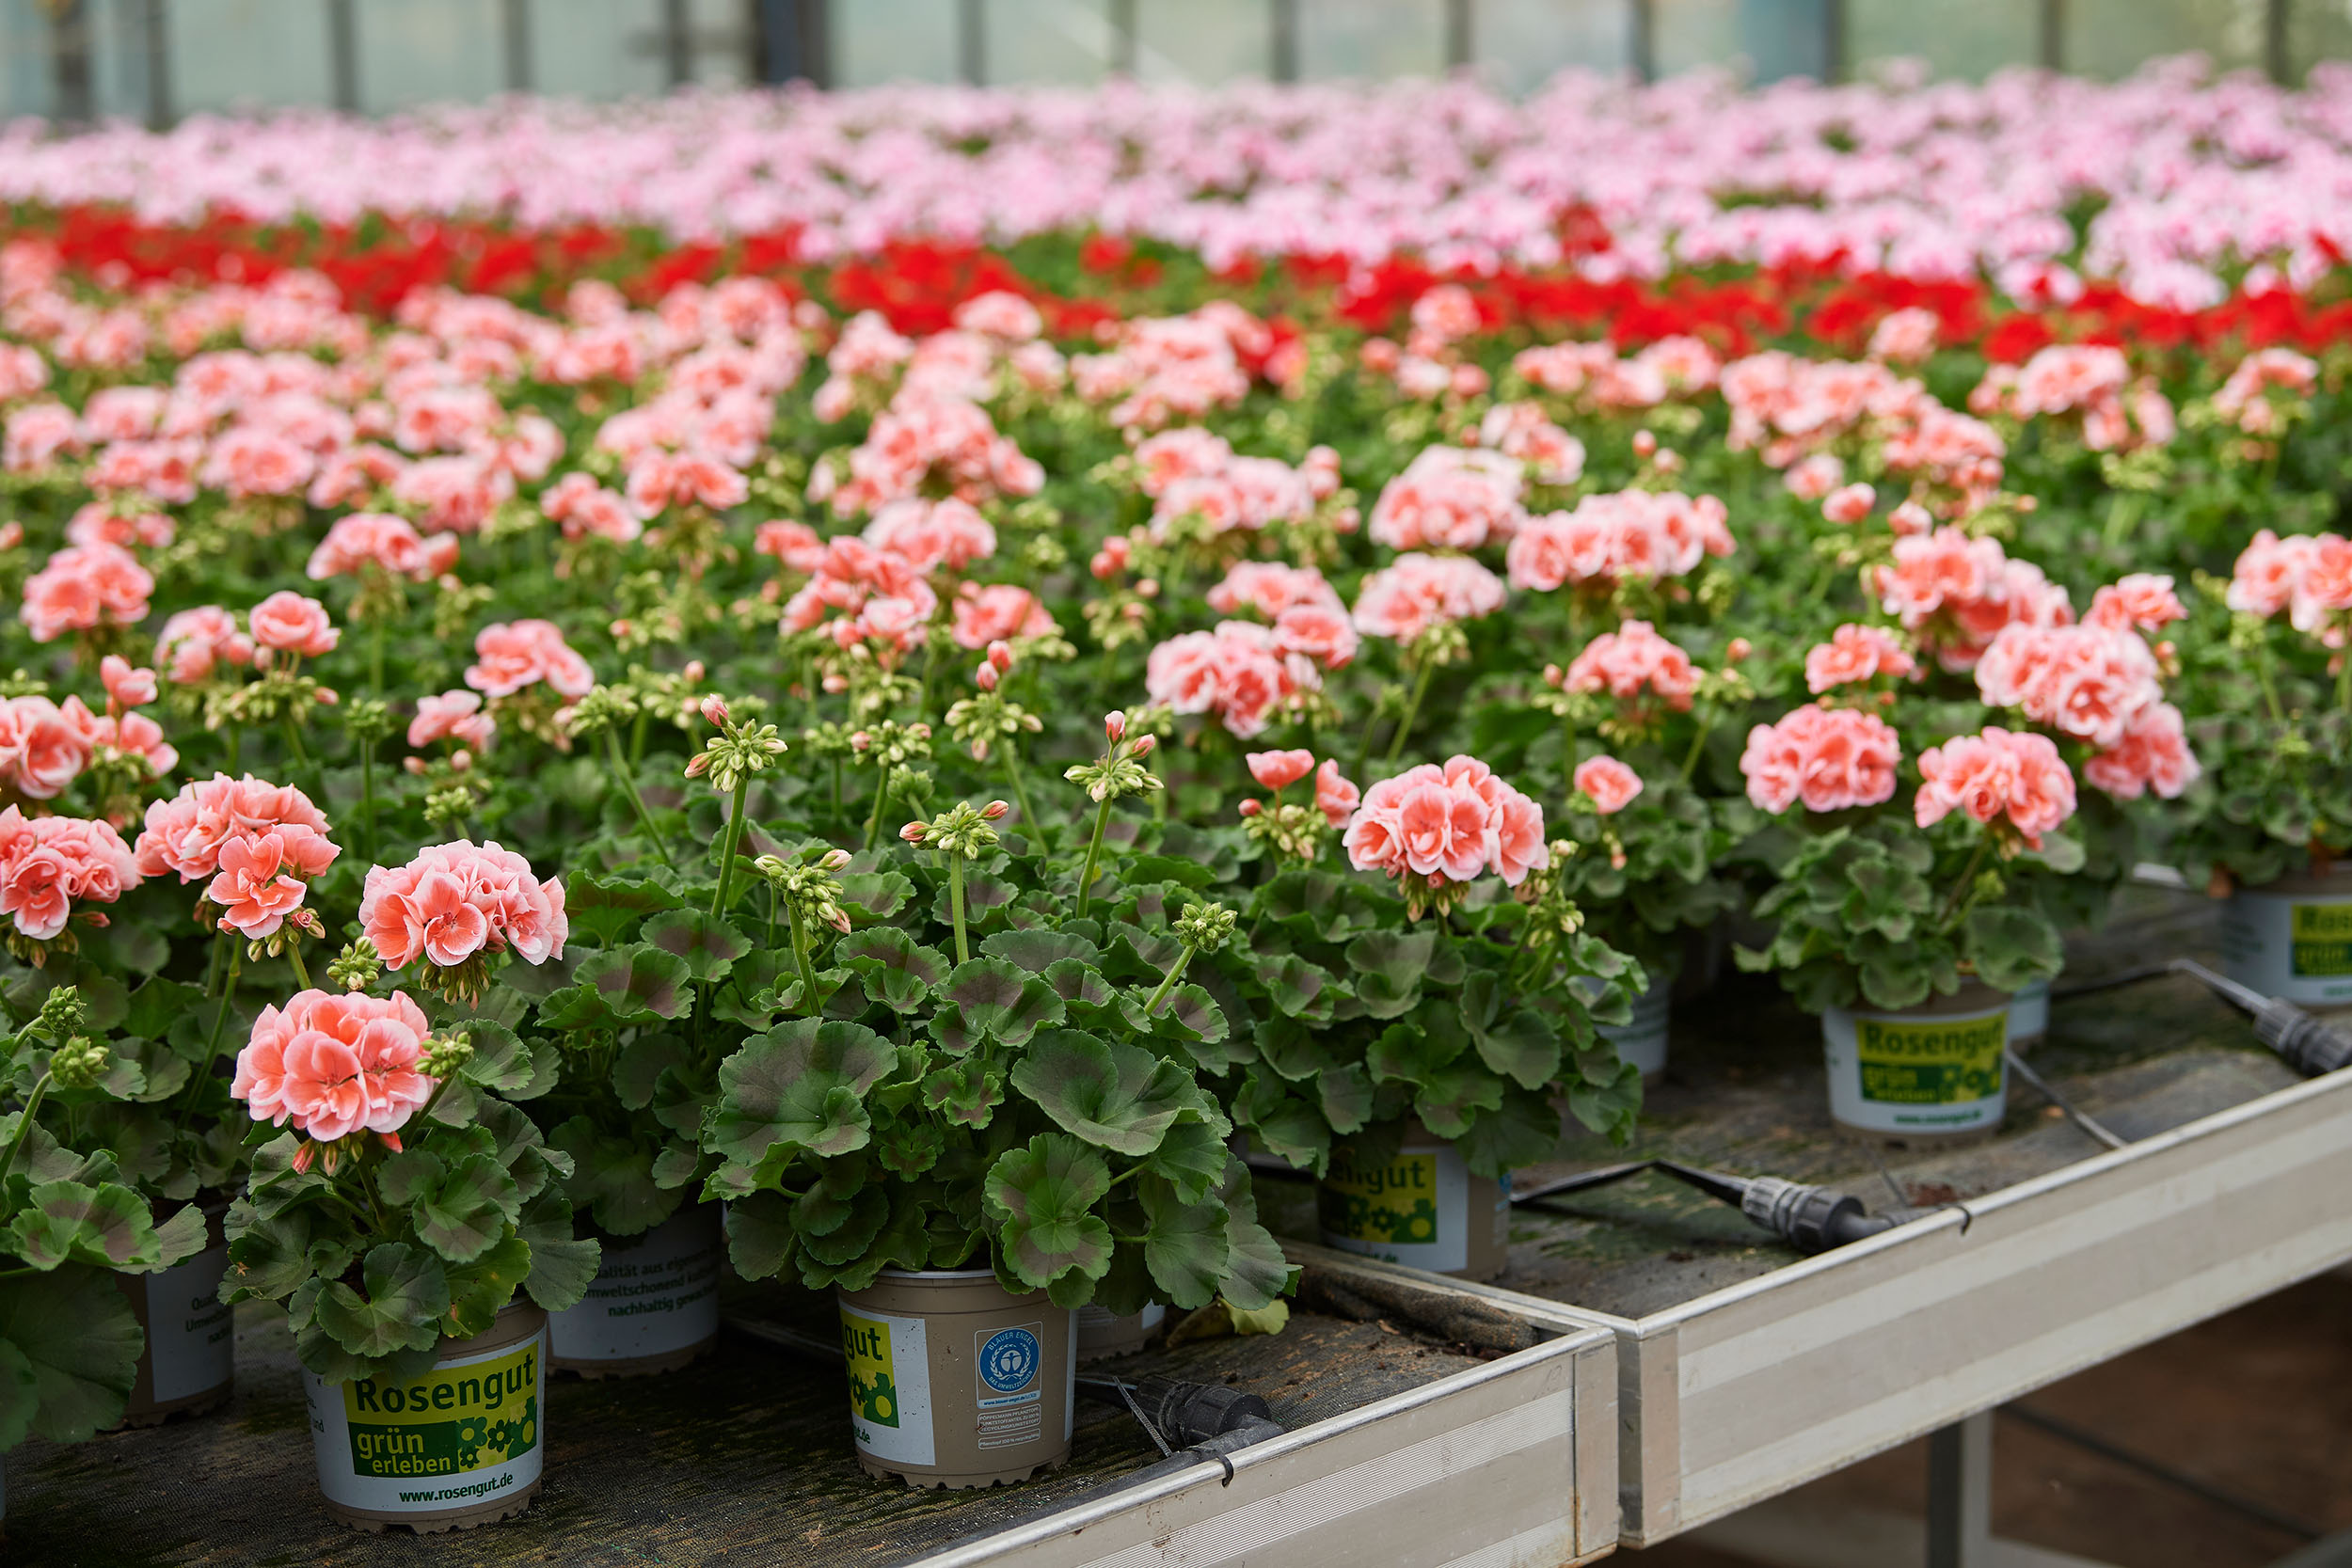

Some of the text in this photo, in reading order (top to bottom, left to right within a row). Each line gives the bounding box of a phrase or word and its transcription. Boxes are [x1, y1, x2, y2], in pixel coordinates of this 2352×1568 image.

[586, 1275, 685, 1298] mweltschonend
[844, 1324, 883, 1361] gut
[988, 1331, 1034, 1351] BLAUER ENGEL
[355, 1354, 534, 1414] Rosengut
[358, 1428, 423, 1459] grün
[373, 1455, 452, 1474] erleben
[399, 1472, 514, 1503] www.rosengut.de
